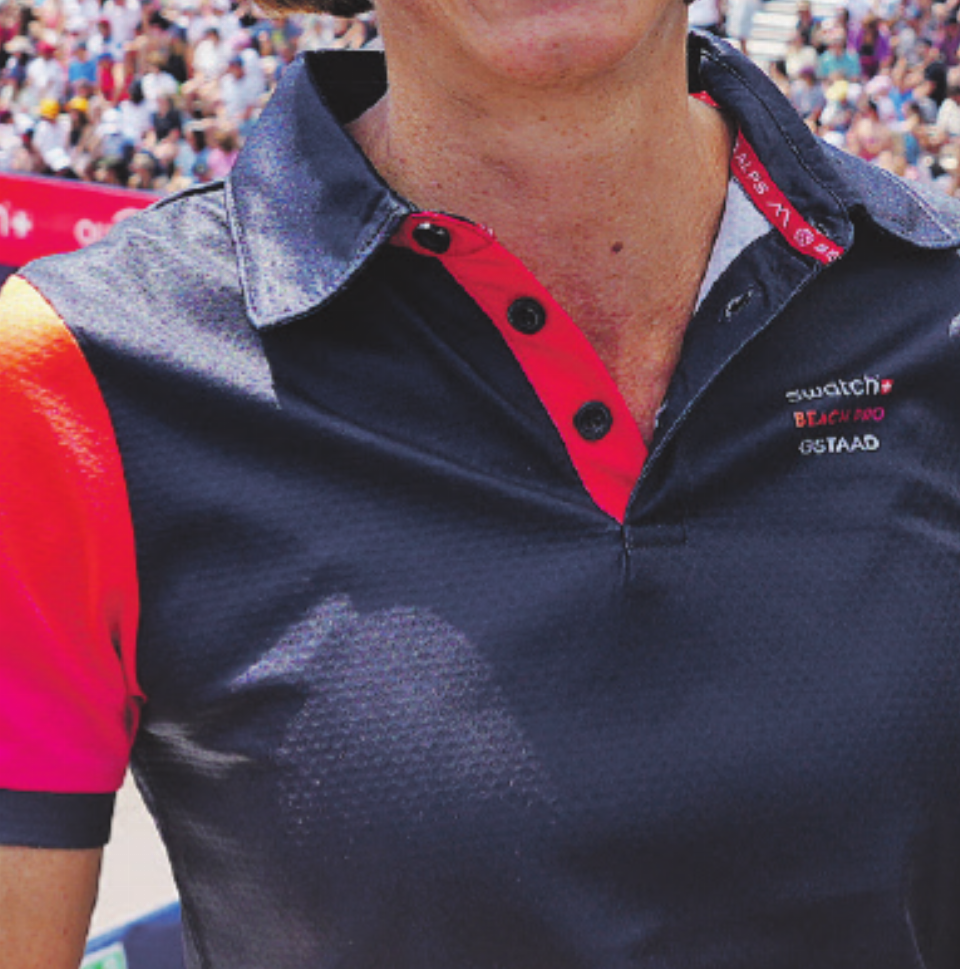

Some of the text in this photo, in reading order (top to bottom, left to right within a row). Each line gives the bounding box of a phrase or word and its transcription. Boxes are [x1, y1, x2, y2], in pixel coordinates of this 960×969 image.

[734, 151, 769, 195] ALPS
[785, 374, 880, 403] swatch
[793, 406, 886, 428] BEACH PRO
[798, 433, 880, 456] GSTAAD
